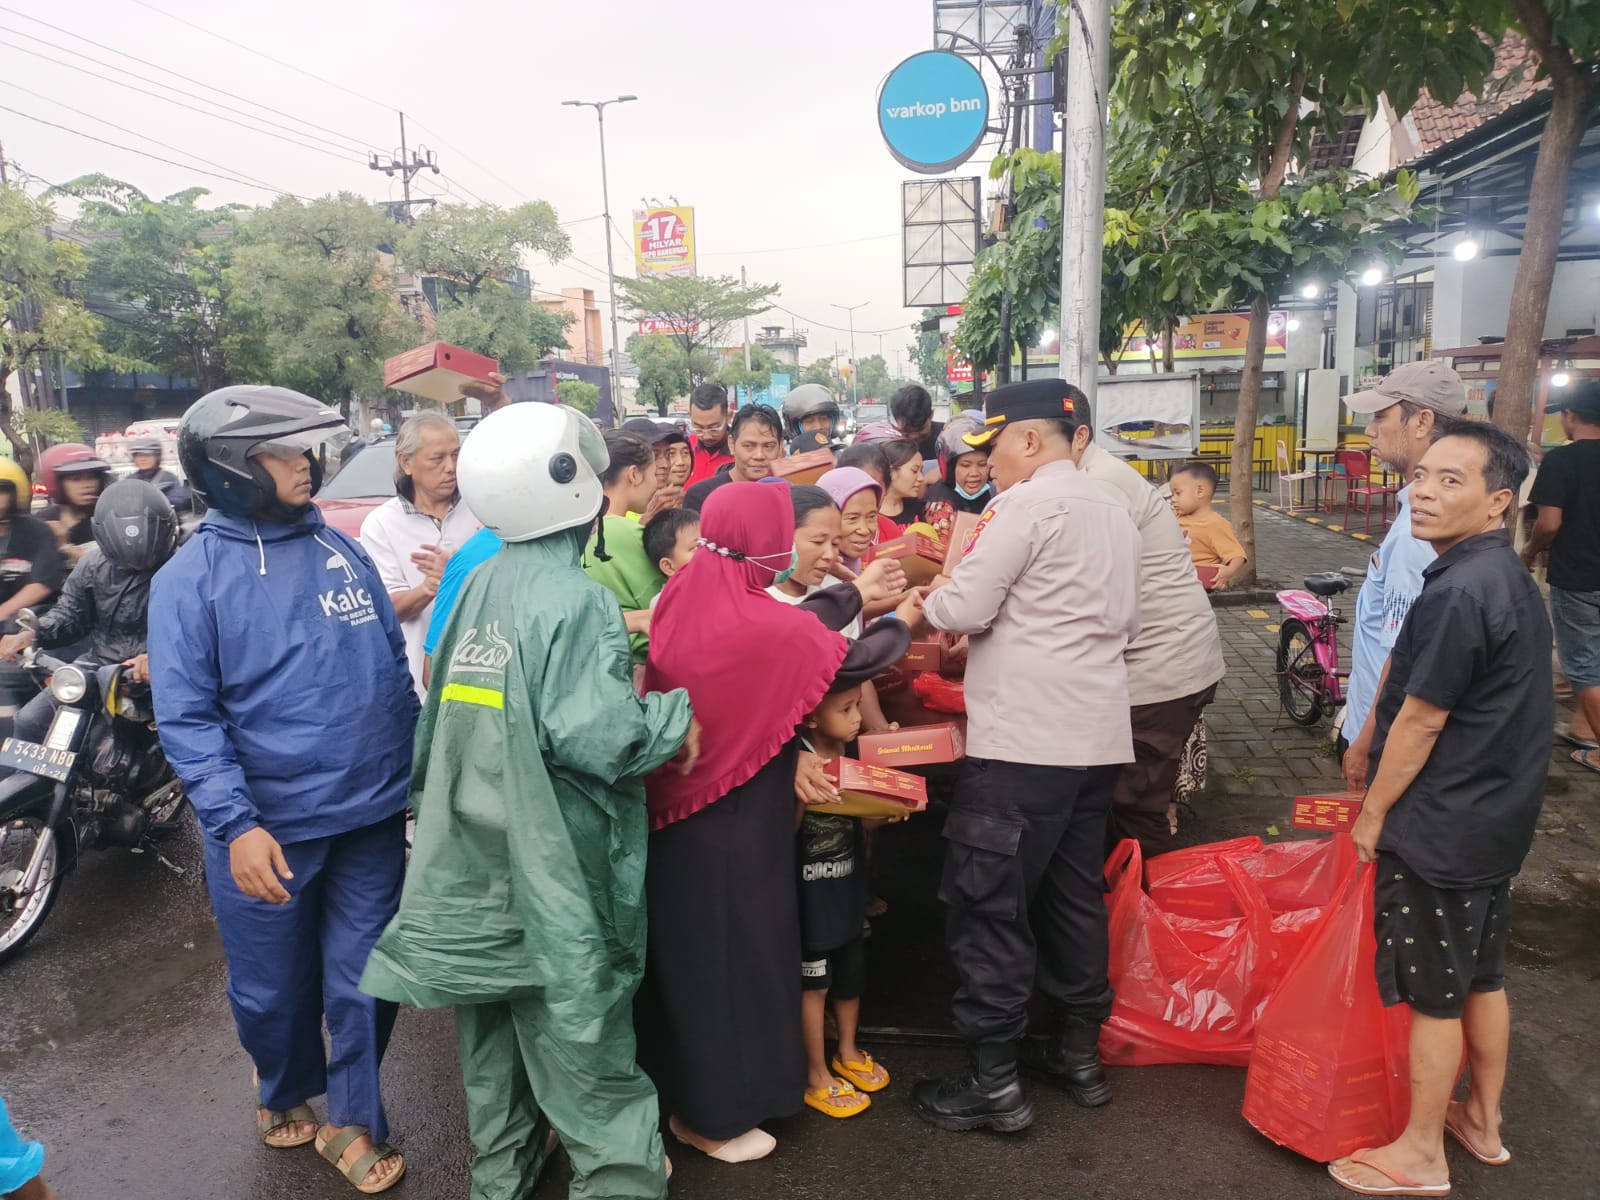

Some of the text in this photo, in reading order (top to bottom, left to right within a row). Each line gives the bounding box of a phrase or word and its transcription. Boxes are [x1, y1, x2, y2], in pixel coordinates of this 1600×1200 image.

[950, 97, 982, 113] bnn
[647, 215, 677, 242] 17
[648, 238, 683, 251] MILYAR
[318, 586, 374, 617] Kalc
[14, 741, 48, 761] 5433
